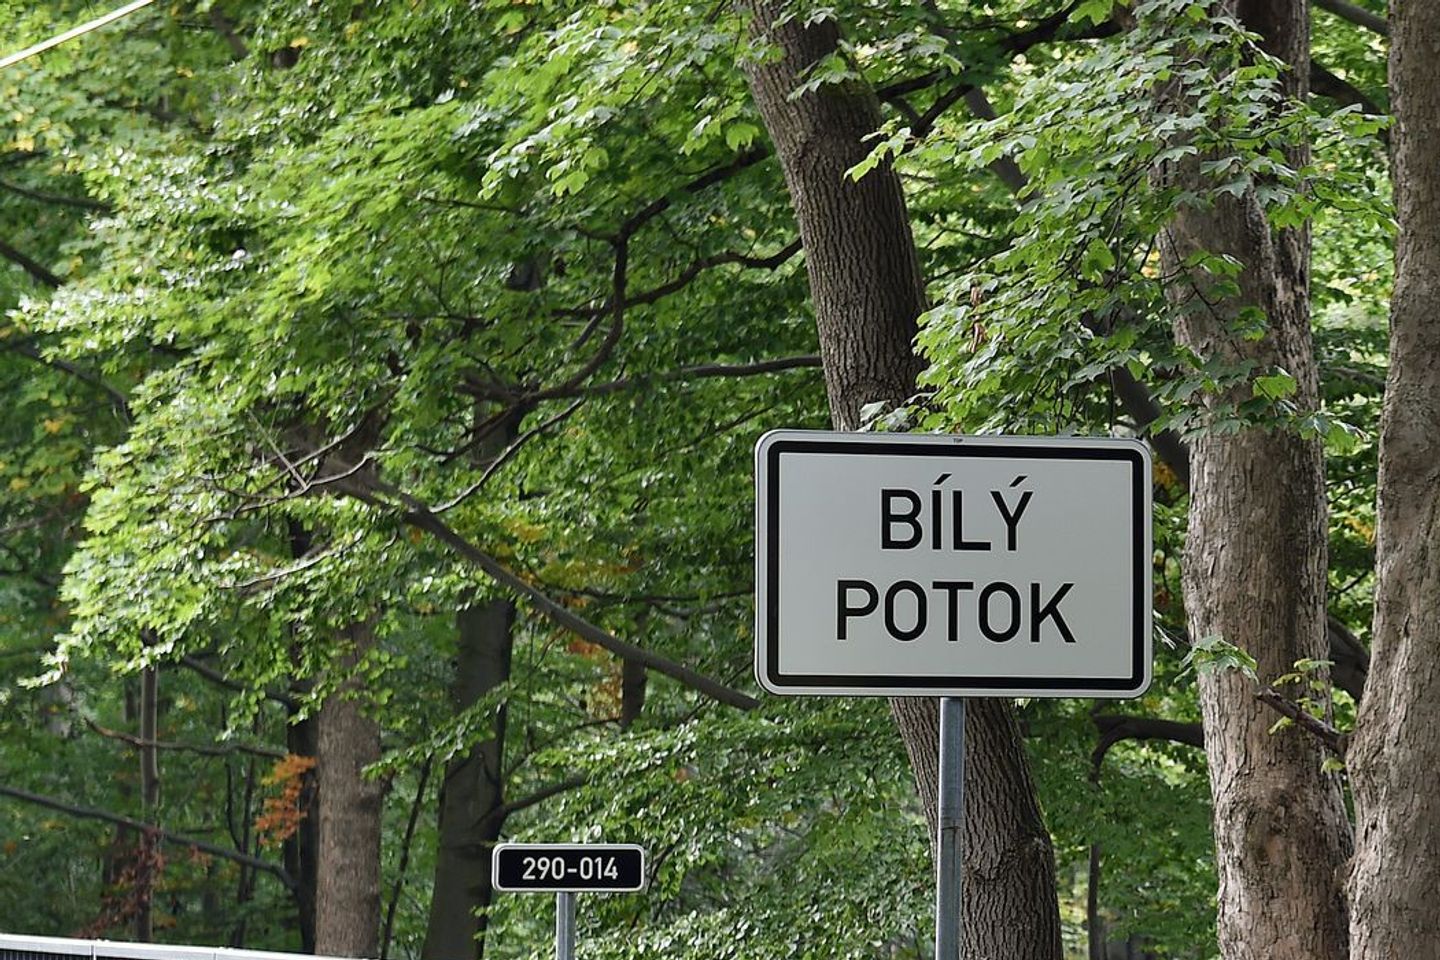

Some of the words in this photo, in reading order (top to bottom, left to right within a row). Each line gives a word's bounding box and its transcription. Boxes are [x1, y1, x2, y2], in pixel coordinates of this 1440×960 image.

[881, 473, 1034, 552] BÍLÝ
[836, 579, 1077, 644] POTOK
[522, 856, 619, 880] 290-014
